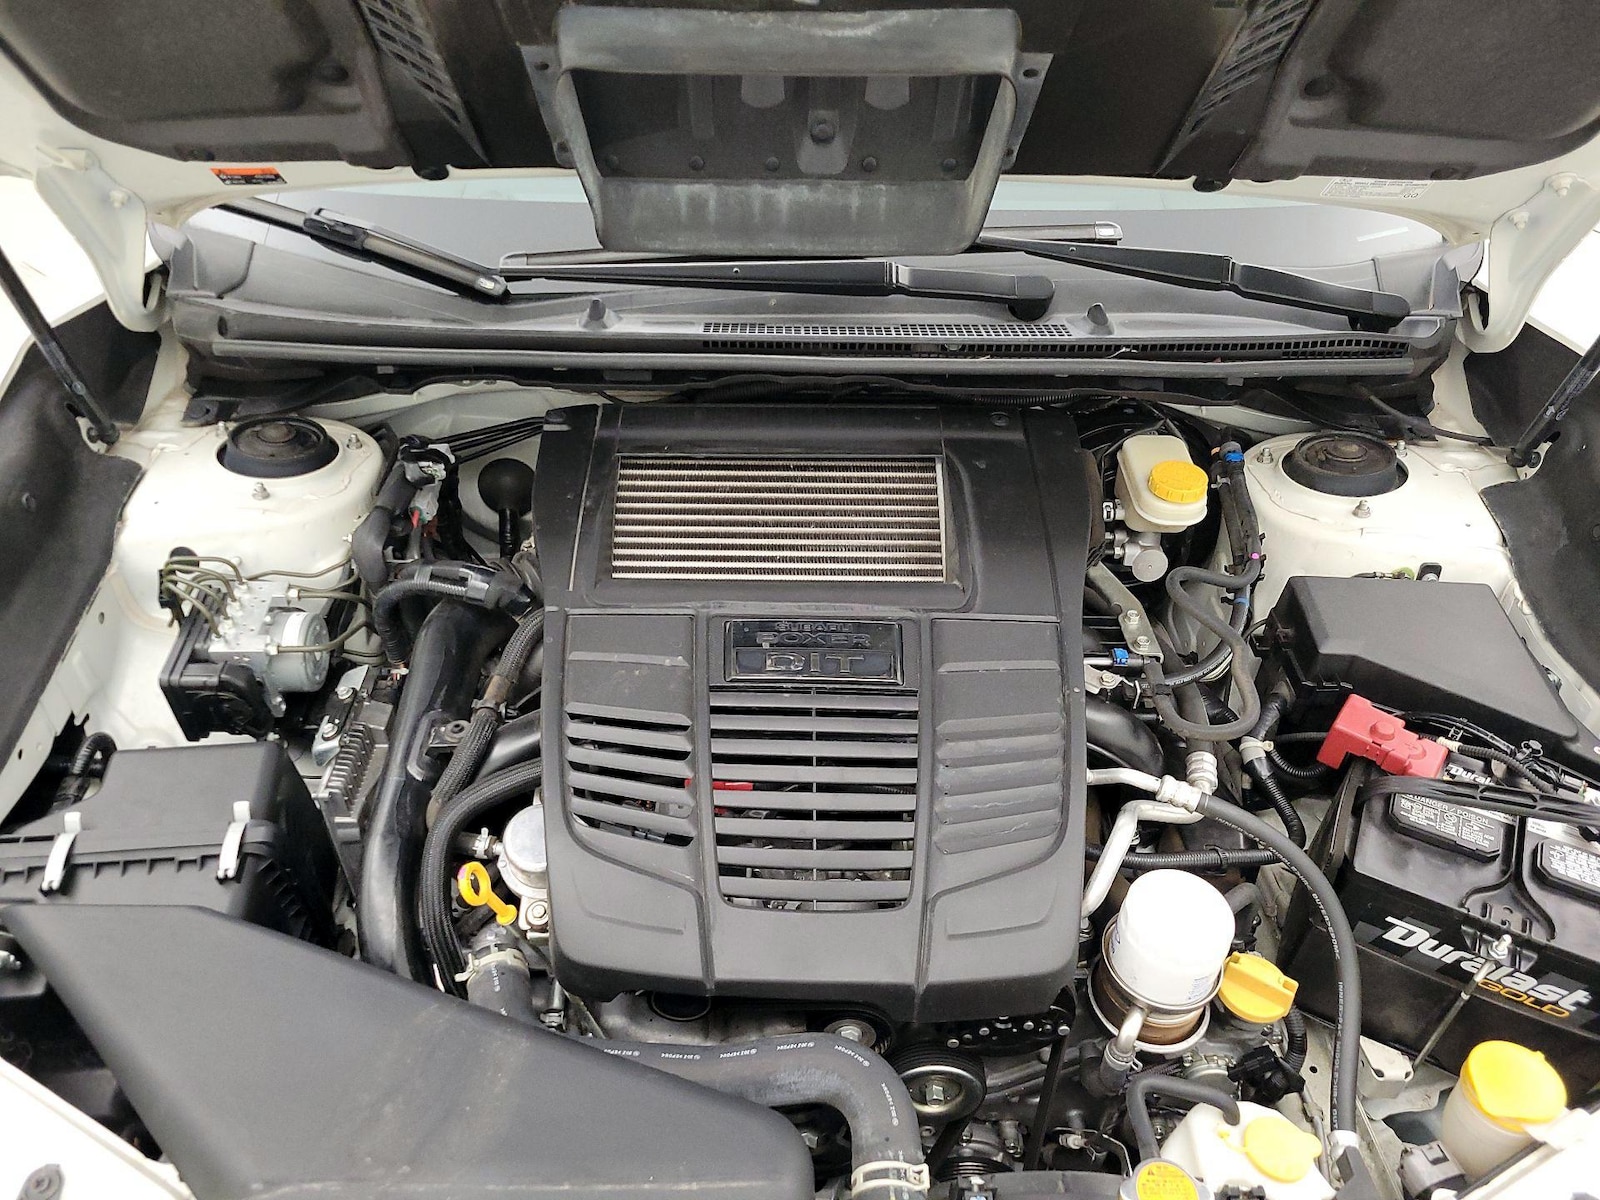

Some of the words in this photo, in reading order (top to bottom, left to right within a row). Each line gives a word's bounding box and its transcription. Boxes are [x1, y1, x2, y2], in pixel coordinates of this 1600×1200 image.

[775, 622, 853, 632] SUBARU
[765, 652, 865, 673] DIT
[1449, 763, 1496, 785] Dural
[1457, 809, 1489, 825] POISON
[1382, 915, 1592, 1012] Duralast
[1478, 978, 1571, 1019] GOLD
